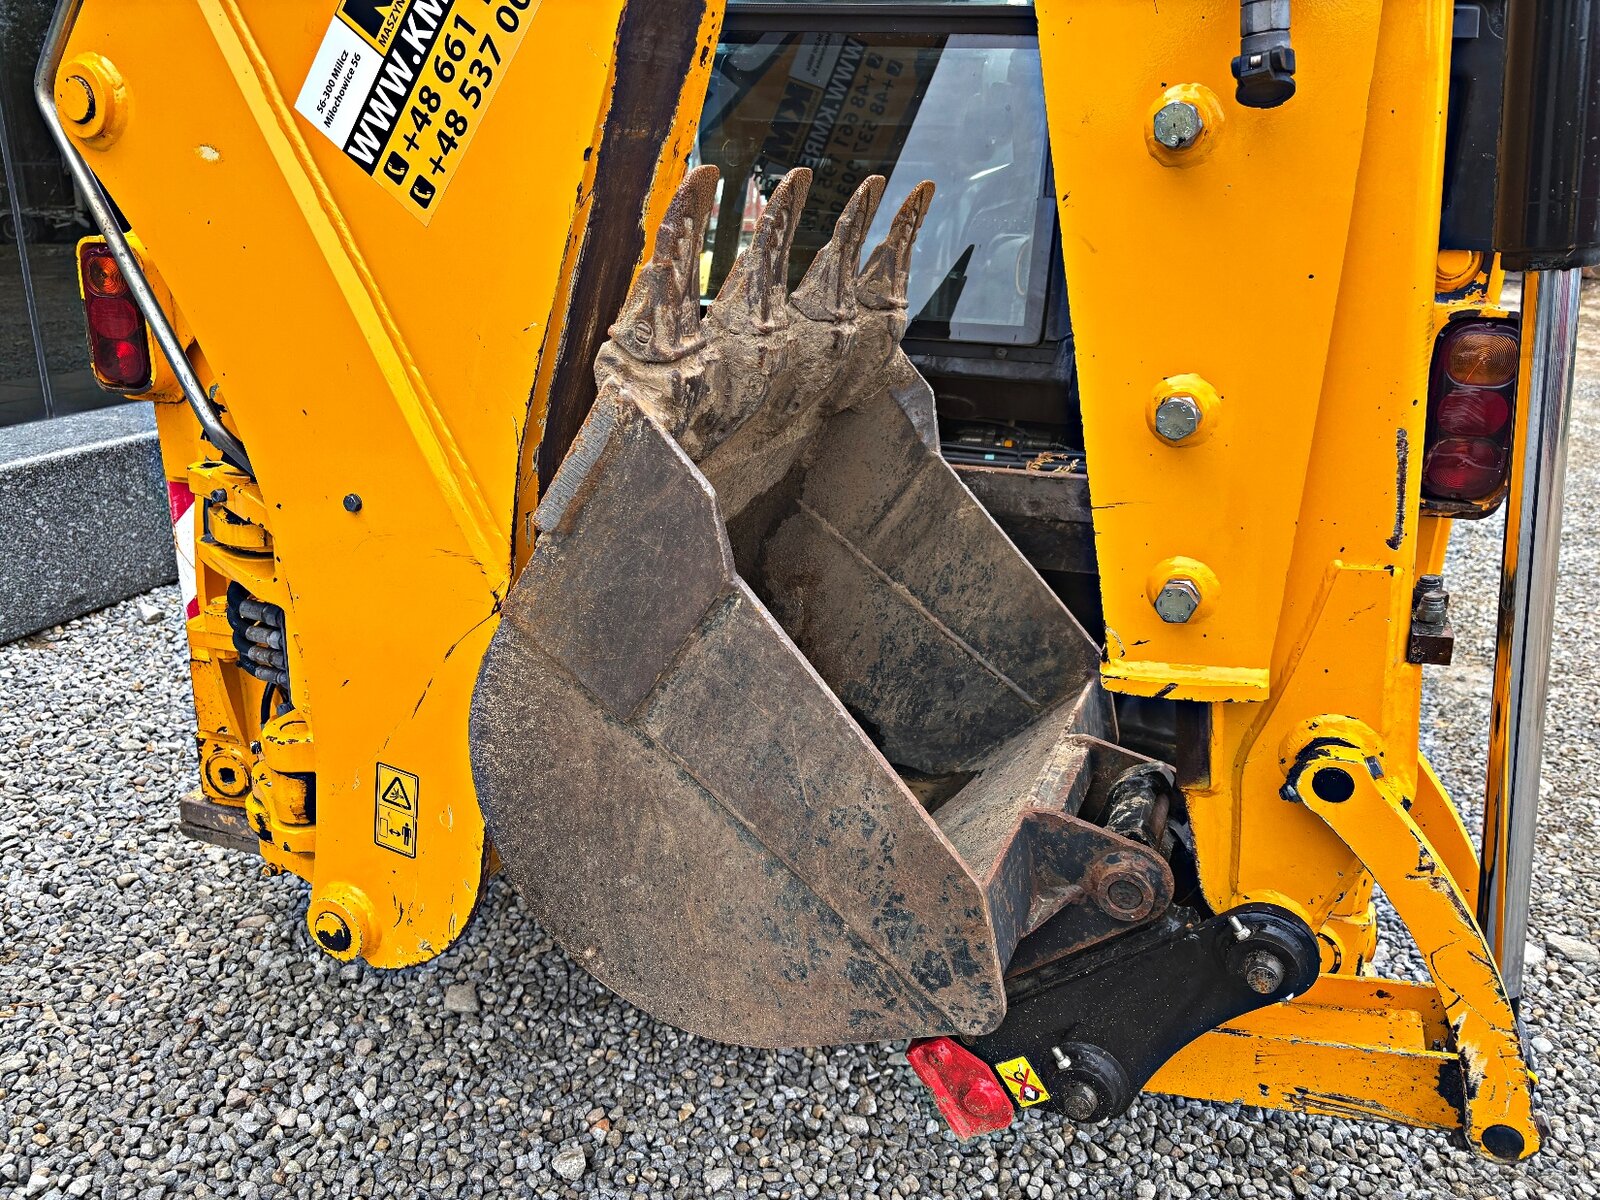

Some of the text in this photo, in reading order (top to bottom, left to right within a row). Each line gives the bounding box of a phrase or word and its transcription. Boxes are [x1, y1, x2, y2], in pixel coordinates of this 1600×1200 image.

[316, 49, 349, 115] 56-300 Milicz
[350, 52, 361, 68] 56
[403, 14, 476, 152] +48 661
[429, 109, 468, 176] +48
[458, 33, 501, 110] 537
